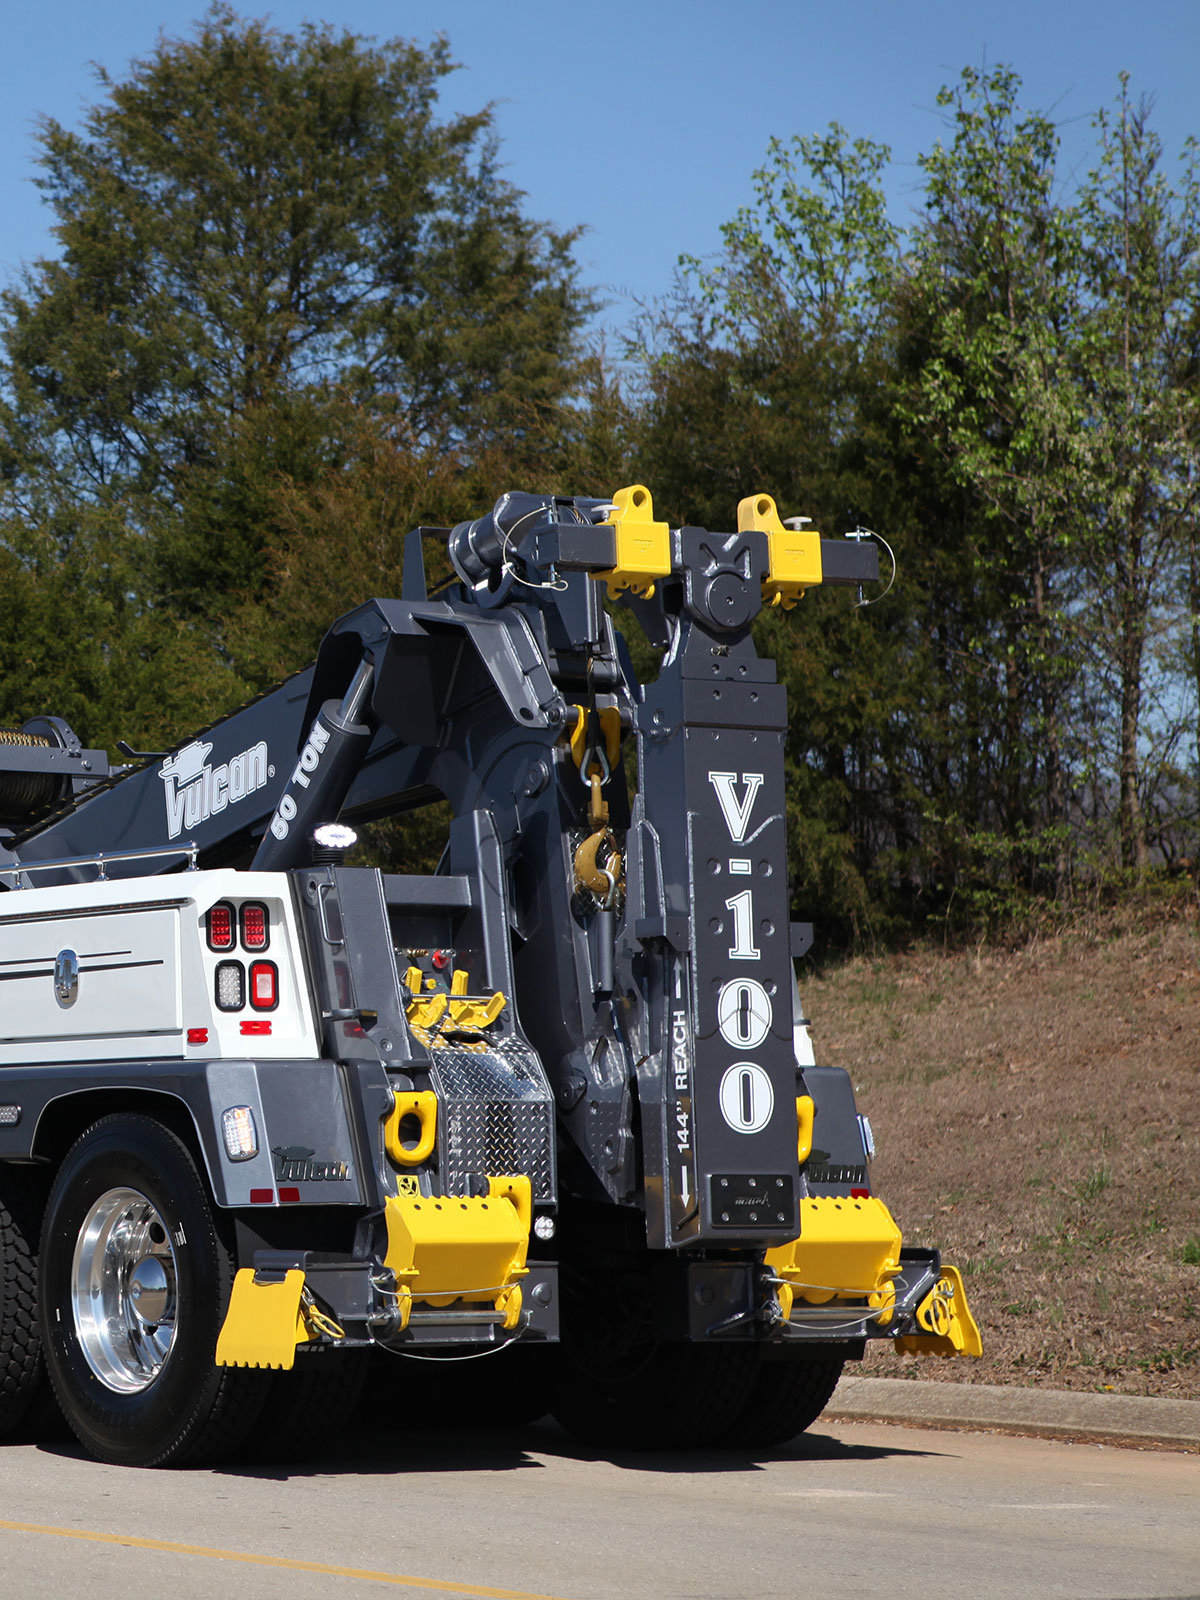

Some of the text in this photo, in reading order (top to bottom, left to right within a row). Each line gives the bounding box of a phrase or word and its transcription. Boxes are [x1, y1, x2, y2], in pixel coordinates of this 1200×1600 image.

[270, 720, 331, 840] 50 TON
[673, 1010, 688, 1090] REACH
